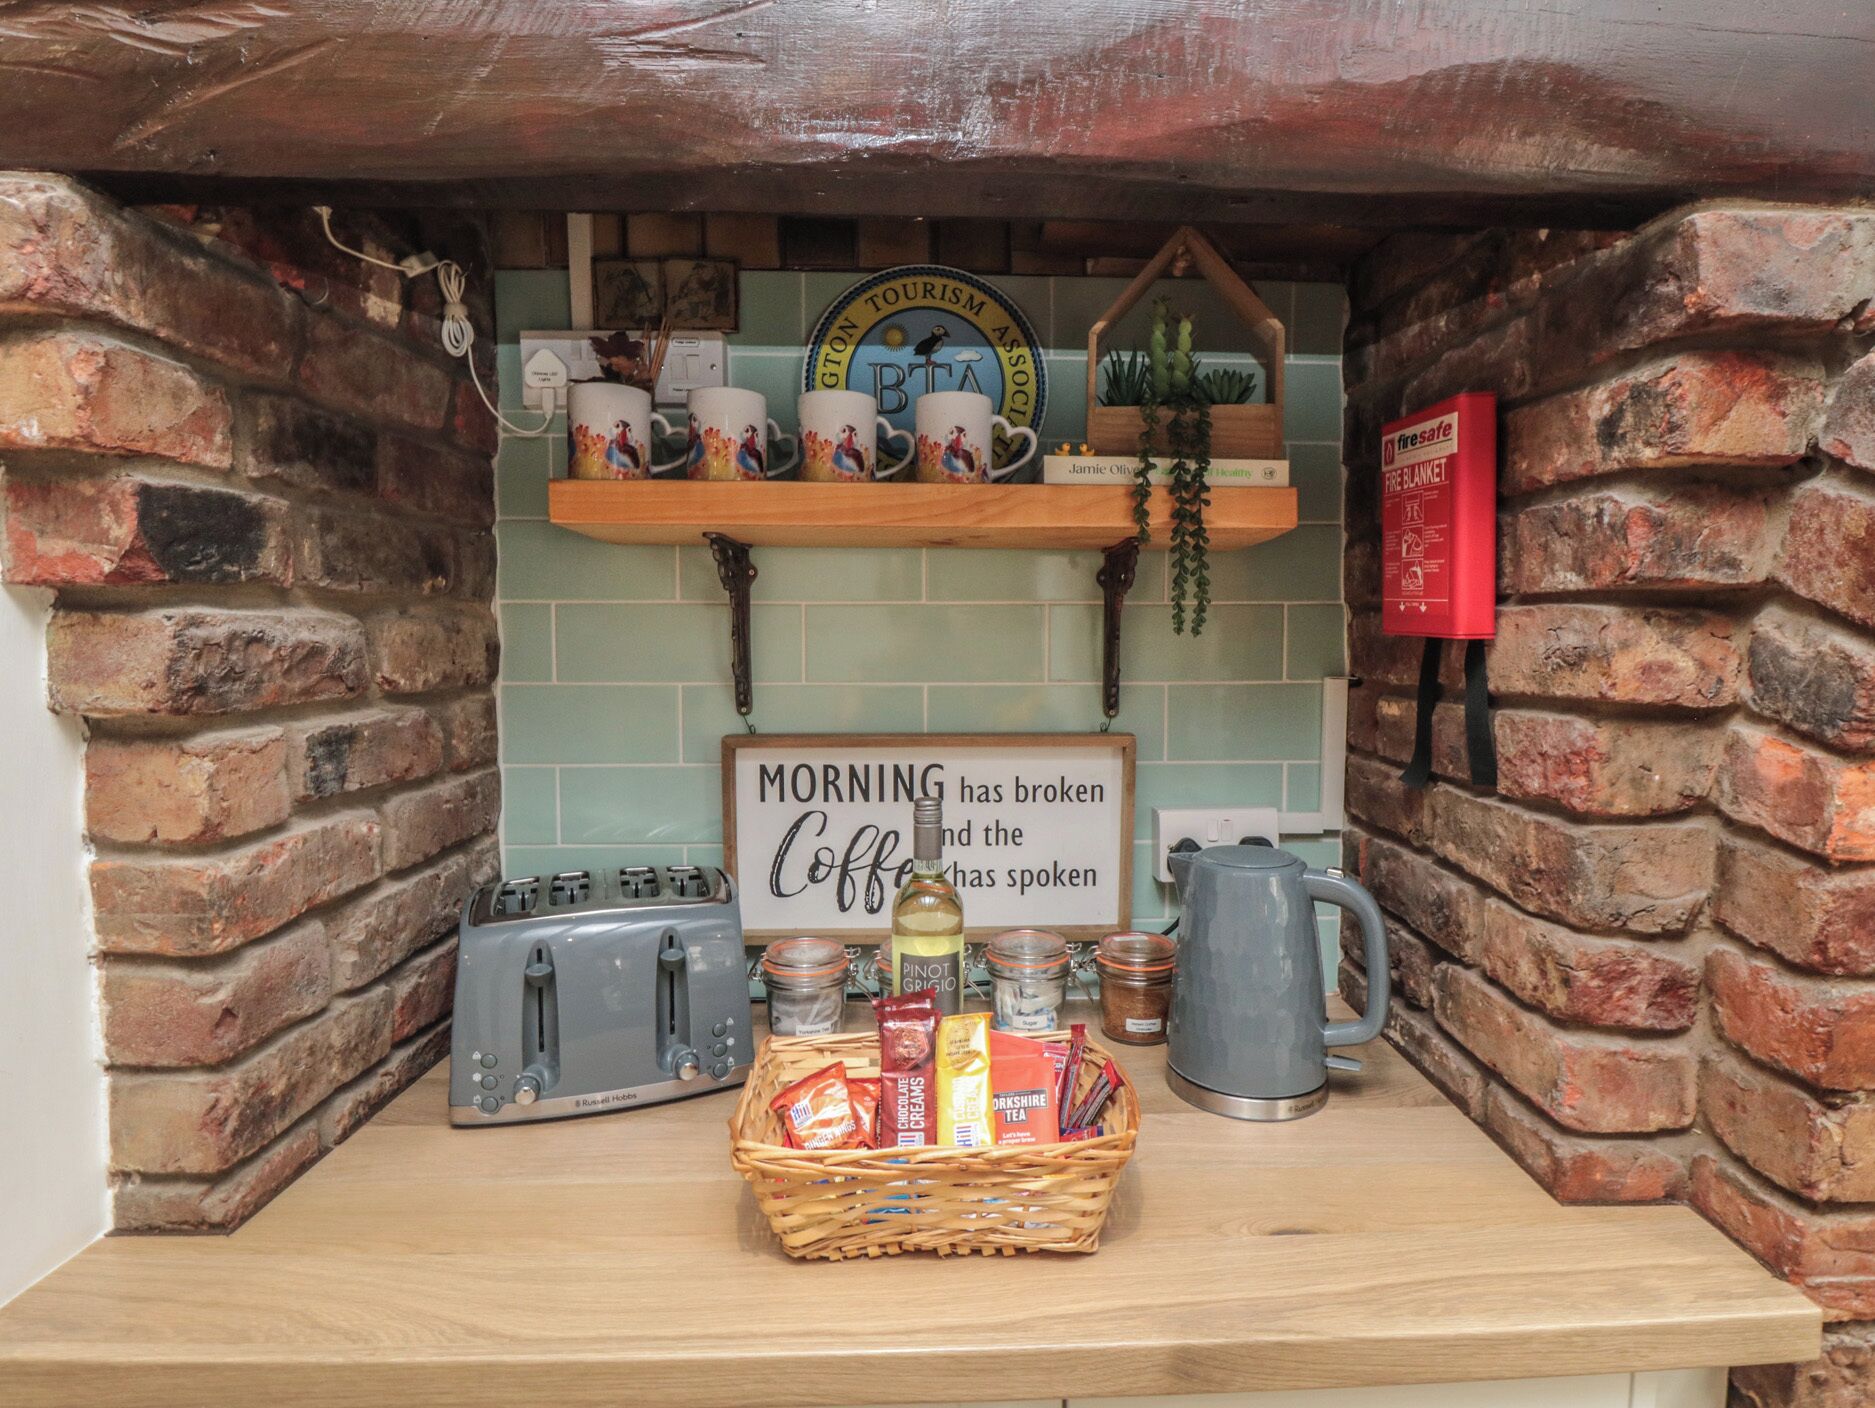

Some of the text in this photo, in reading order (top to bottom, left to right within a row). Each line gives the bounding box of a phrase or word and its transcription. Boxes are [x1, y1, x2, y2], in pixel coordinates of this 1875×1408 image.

[821, 316, 860, 388] GTON
[865, 282, 987, 318] TOURISM
[1397, 419, 1452, 450] firesafe
[1068, 463, 1106, 475] Jamie
[1109, 463, 1140, 475] Olive
[1215, 467, 1253, 480] Healthy
[1385, 458, 1447, 494] FIRE BLANKET
[758, 763, 1105, 803] MORNING has broken
[942, 820, 1024, 846] nd the
[769, 810, 932, 915] Coffe
[953, 860, 1098, 895] has spoken
[903, 963, 950, 979] PINOT
[903, 976, 957, 993] GRIGIO
[1022, 1019, 1038, 1027] Sugar
[582, 1092, 638, 1107] Russell Hobbs
[897, 1077, 909, 1129] CHOCOLATE
[910, 1077, 925, 1129] CREAMS
[993, 1094, 1046, 1110] ORKSHIRE
[1005, 1109, 1027, 1122] TEA
